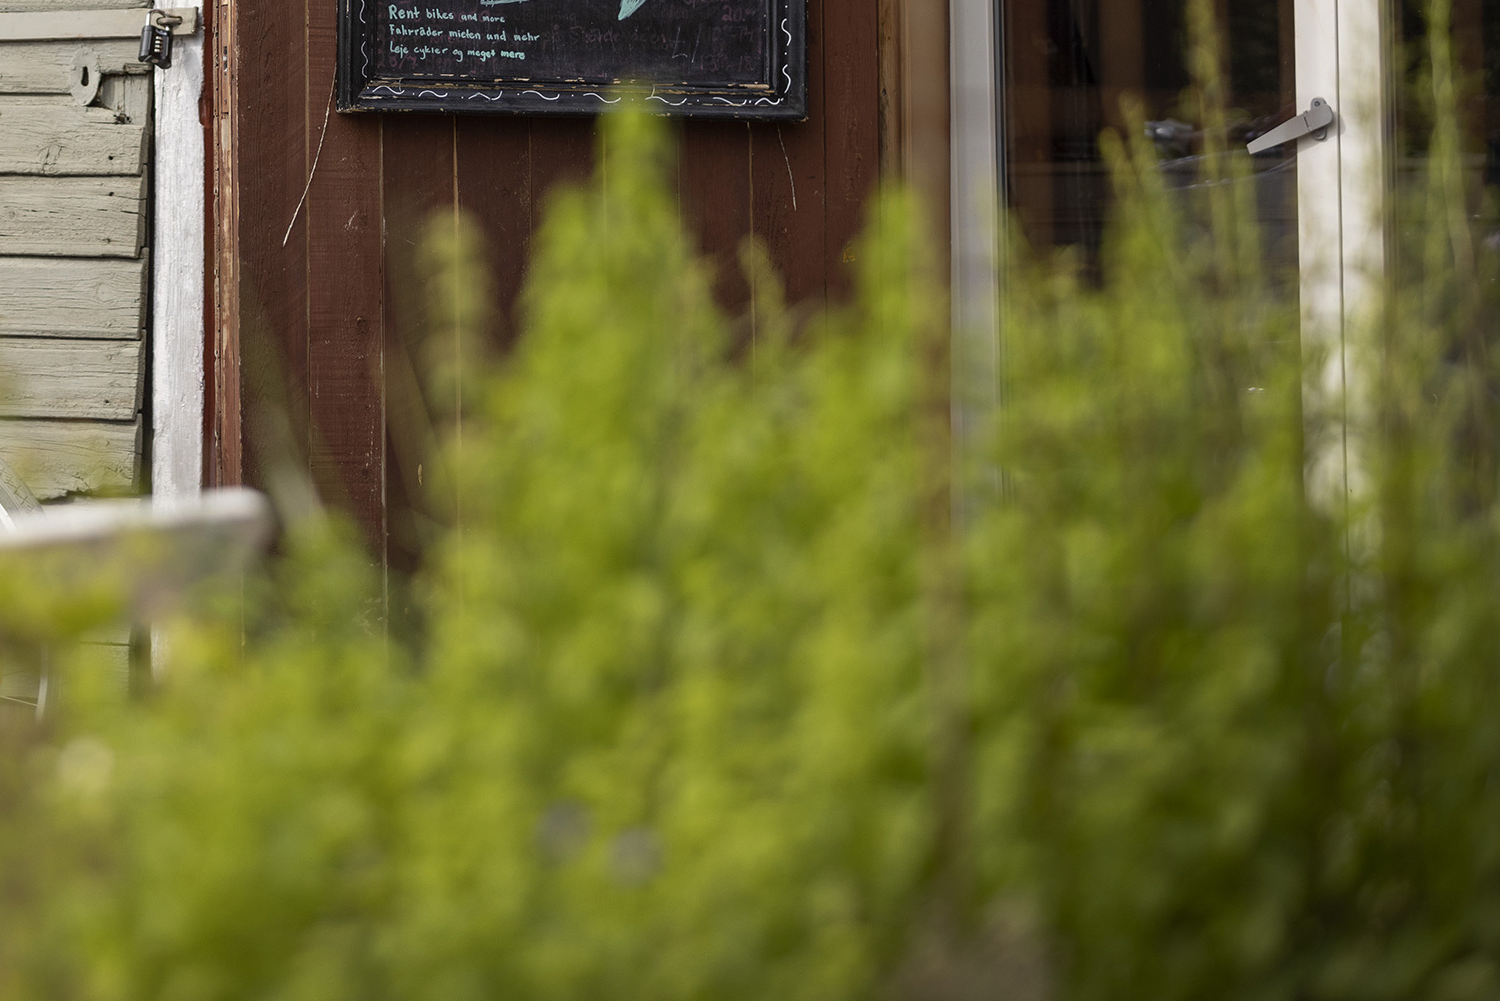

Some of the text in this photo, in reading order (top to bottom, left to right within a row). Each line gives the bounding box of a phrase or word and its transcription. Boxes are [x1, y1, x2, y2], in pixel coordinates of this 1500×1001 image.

[388, 4, 505, 23] Rent bikes and more
[450, 29, 481, 40] mieten
[487, 30, 506, 41] und
[513, 32, 540, 41] mehr
[389, 41, 409, 58] Leje
[452, 49, 463, 63] og
[467, 49, 496, 62] meget
[501, 51, 525, 60] mere
